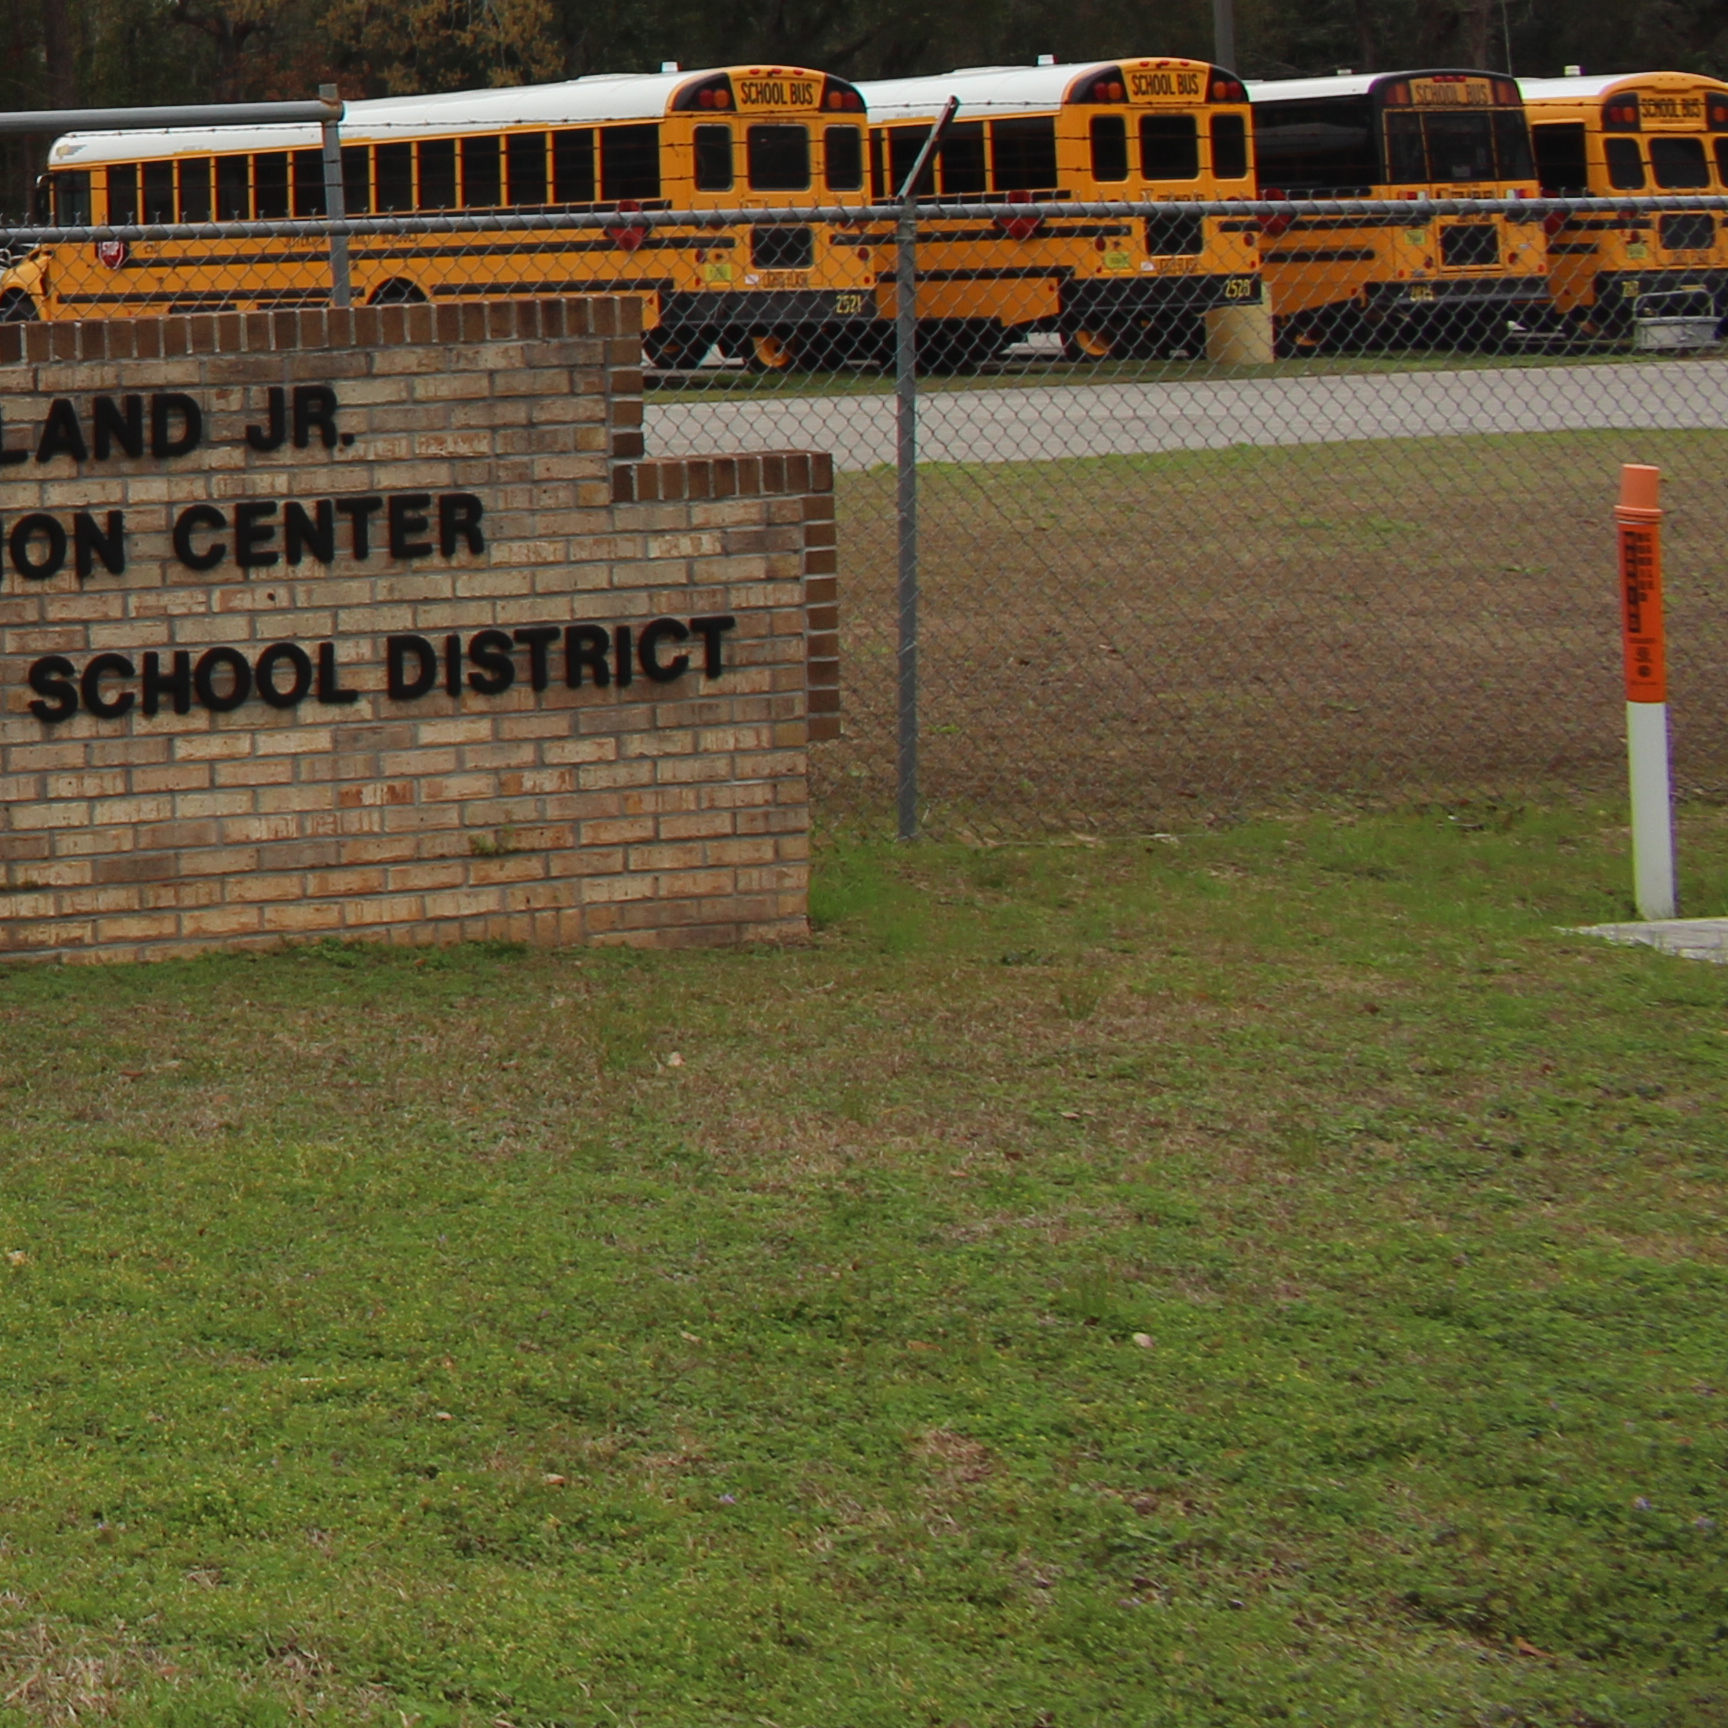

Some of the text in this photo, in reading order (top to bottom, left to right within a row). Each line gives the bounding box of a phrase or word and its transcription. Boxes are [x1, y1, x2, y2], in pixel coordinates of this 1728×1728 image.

[741, 82, 814, 105] SCHOOL BUS
[1131, 74, 1199, 96] SCHOOL BUS
[1415, 83, 1487, 105] SCHOOL BUS
[1642, 98, 1676, 118] SCHOOL
[835, 294, 861, 314] 2521
[245, 384, 355, 452] JR.
[172, 492, 486, 572] CENTER
[28, 642, 360, 726] SCHOOL
[386, 615, 737, 703] DISTRICT
